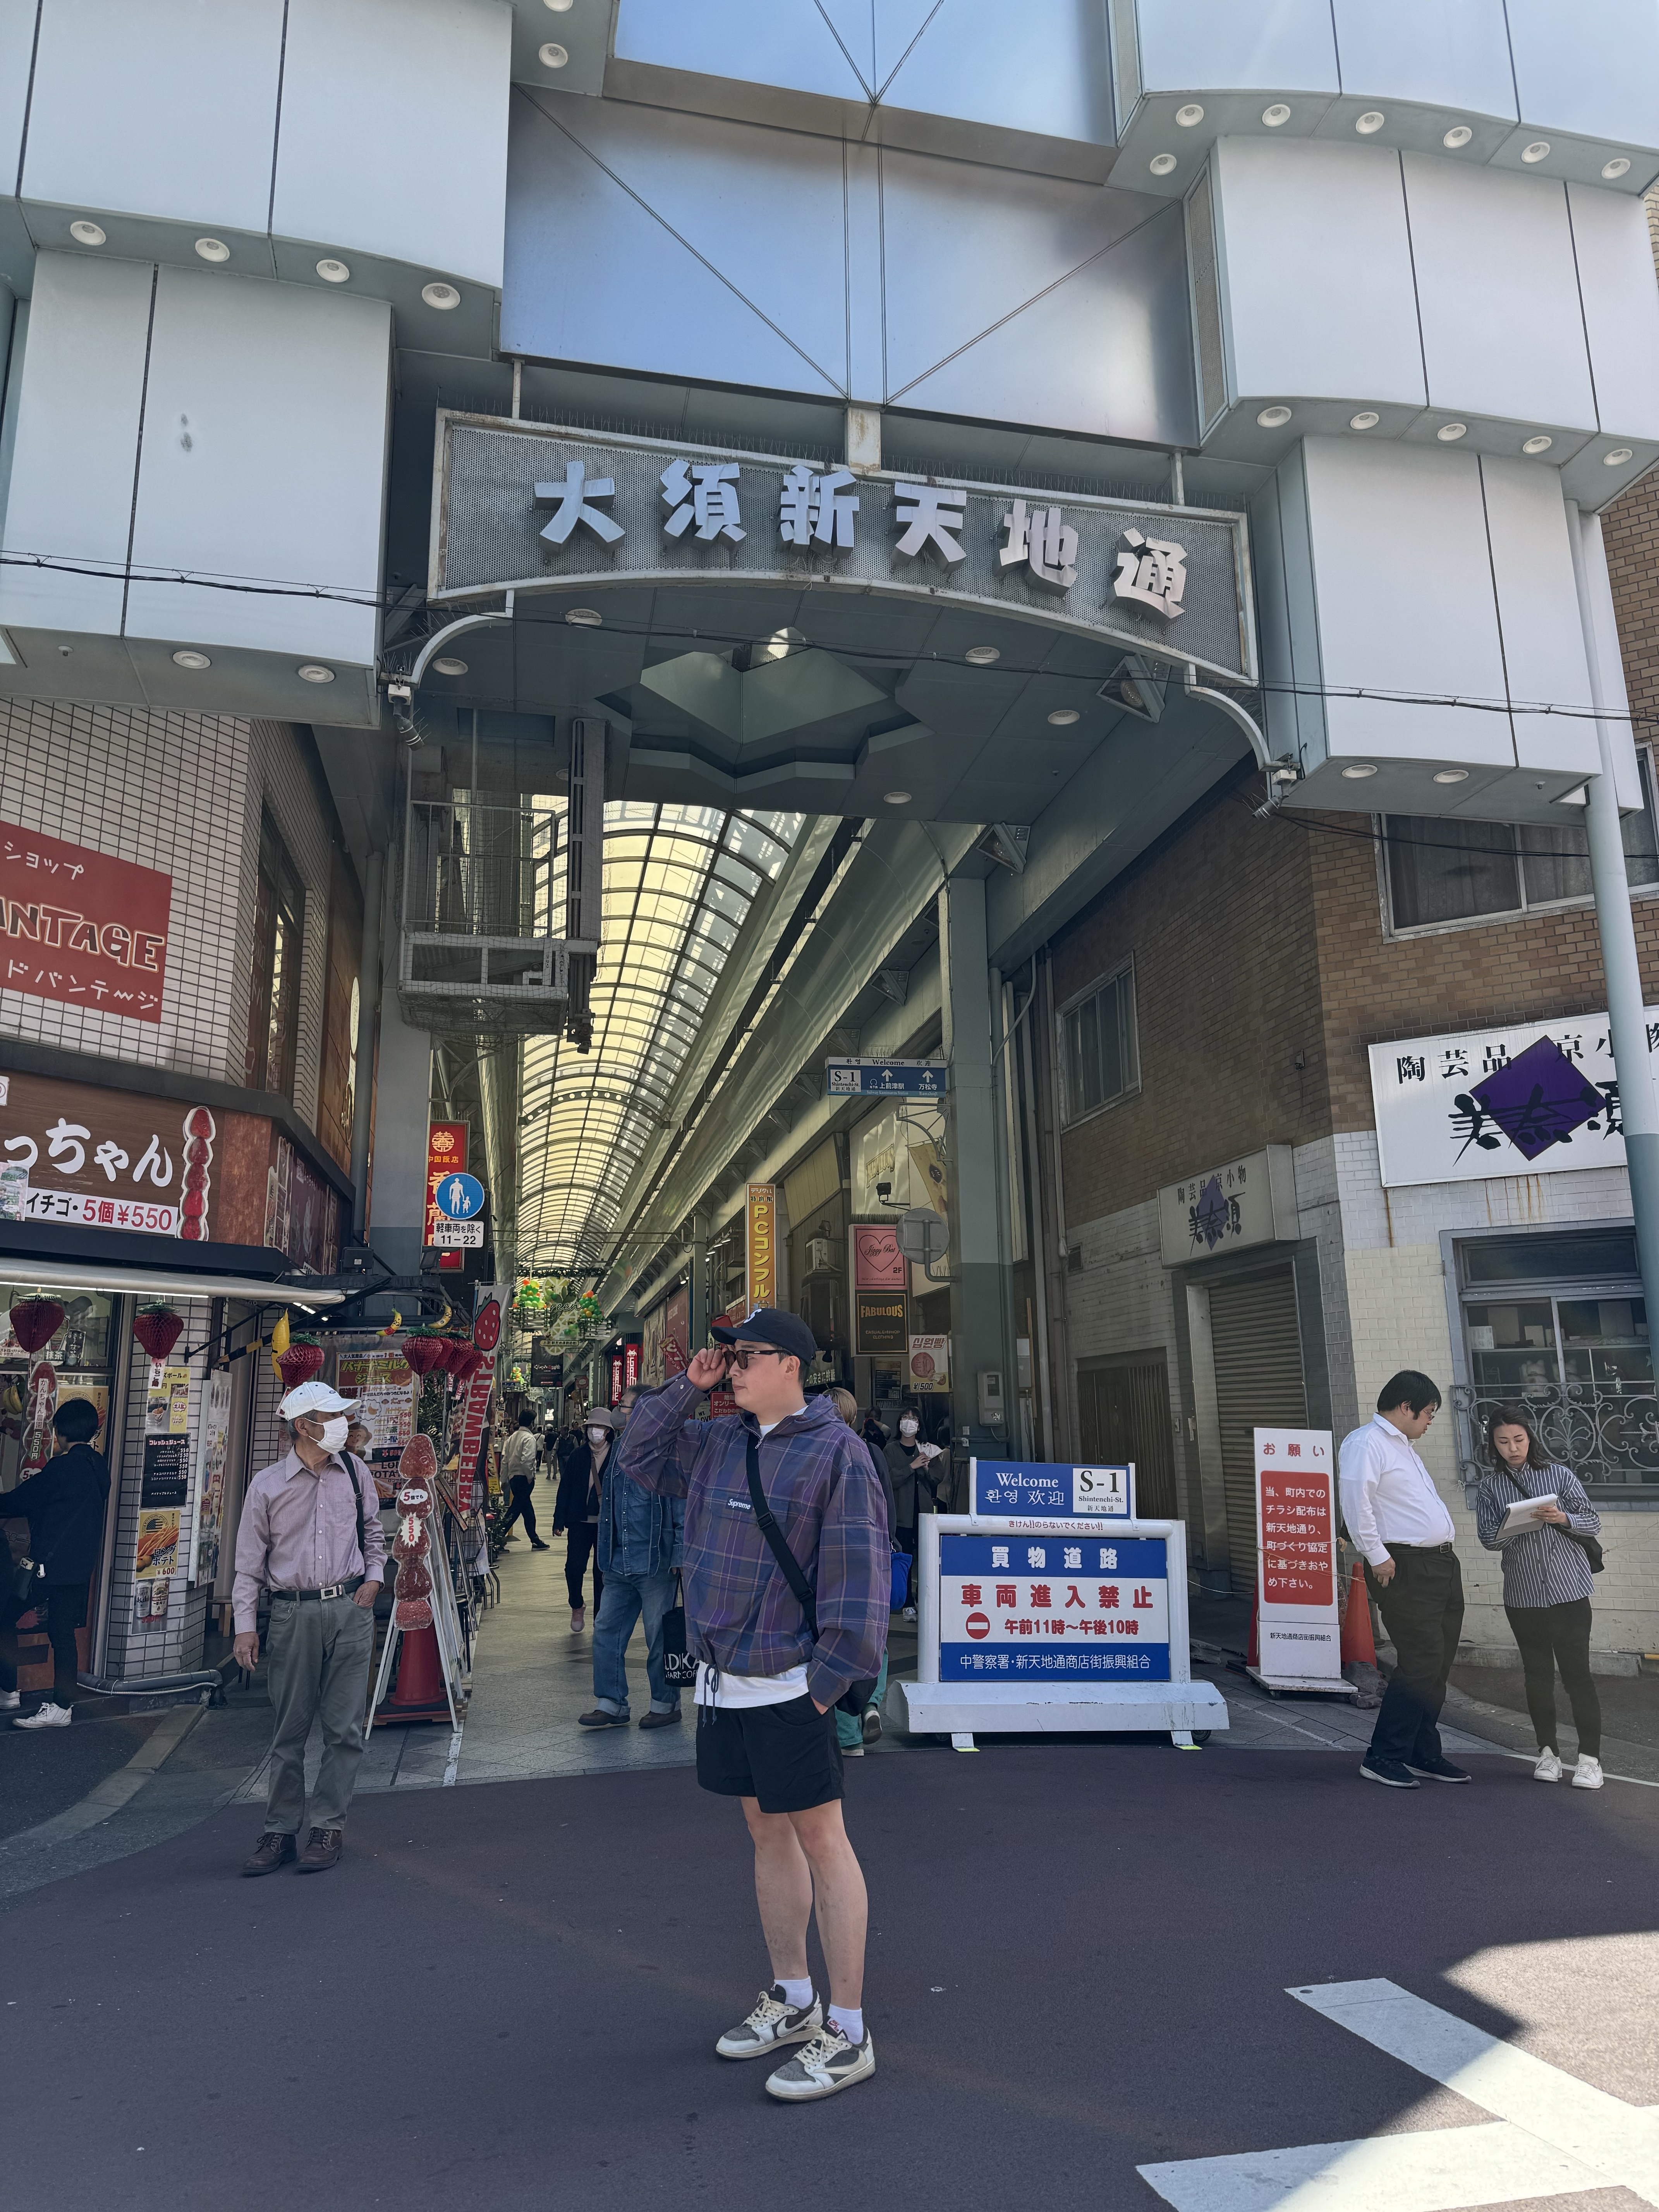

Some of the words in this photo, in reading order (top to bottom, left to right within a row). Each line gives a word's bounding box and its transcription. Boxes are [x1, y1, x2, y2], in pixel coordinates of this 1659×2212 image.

[535, 459, 1187, 624] 大須新天地通
[4, 841, 84, 880] ショップ
[1396, 1044, 1512, 1084] 陶芸品
[834, 1071, 855, 1082] S-1
[4, 1118, 173, 1187] っちゃん
[436, 1223, 481, 1233] 軽車両を除く
[753, 1205, 771, 1298] PCコンフル
[860, 1304, 903, 1318] FABULOUS
[912, 1338, 946, 1349] 십원빵
[46, 1351, 62, 1360] 抹茶
[356, 1372, 392, 1384] ジュース
[1263, 1443, 1325, 1457] お願い
[996, 1472, 1059, 1487] Welcome
[1080, 1470, 1120, 1493] S-1
[985, 1490, 1018, 1504] 환영
[1027, 1490, 1064, 1505] 欢迎
[1265, 1486, 1326, 1499] 当、町内での
[728, 1498, 751, 1510] Supreme
[1078, 1496, 1124, 1504] Shintenchi-St.
[1266, 1505, 1326, 1517] チラシ配布は
[1266, 1522, 1322, 1535] 新天地通り、
[154, 1546, 177, 1556] ロング
[1266, 1540, 1328, 1553] 町づくり協定
[153, 1556, 174, 1566] ポテト
[991, 1546, 1118, 1569] 買物道路
[1267, 1559, 1328, 1572] に基づきおや
[1267, 1577, 1314, 1590] め下さい。
[961, 1584, 1153, 1609] 車両進入禁止
